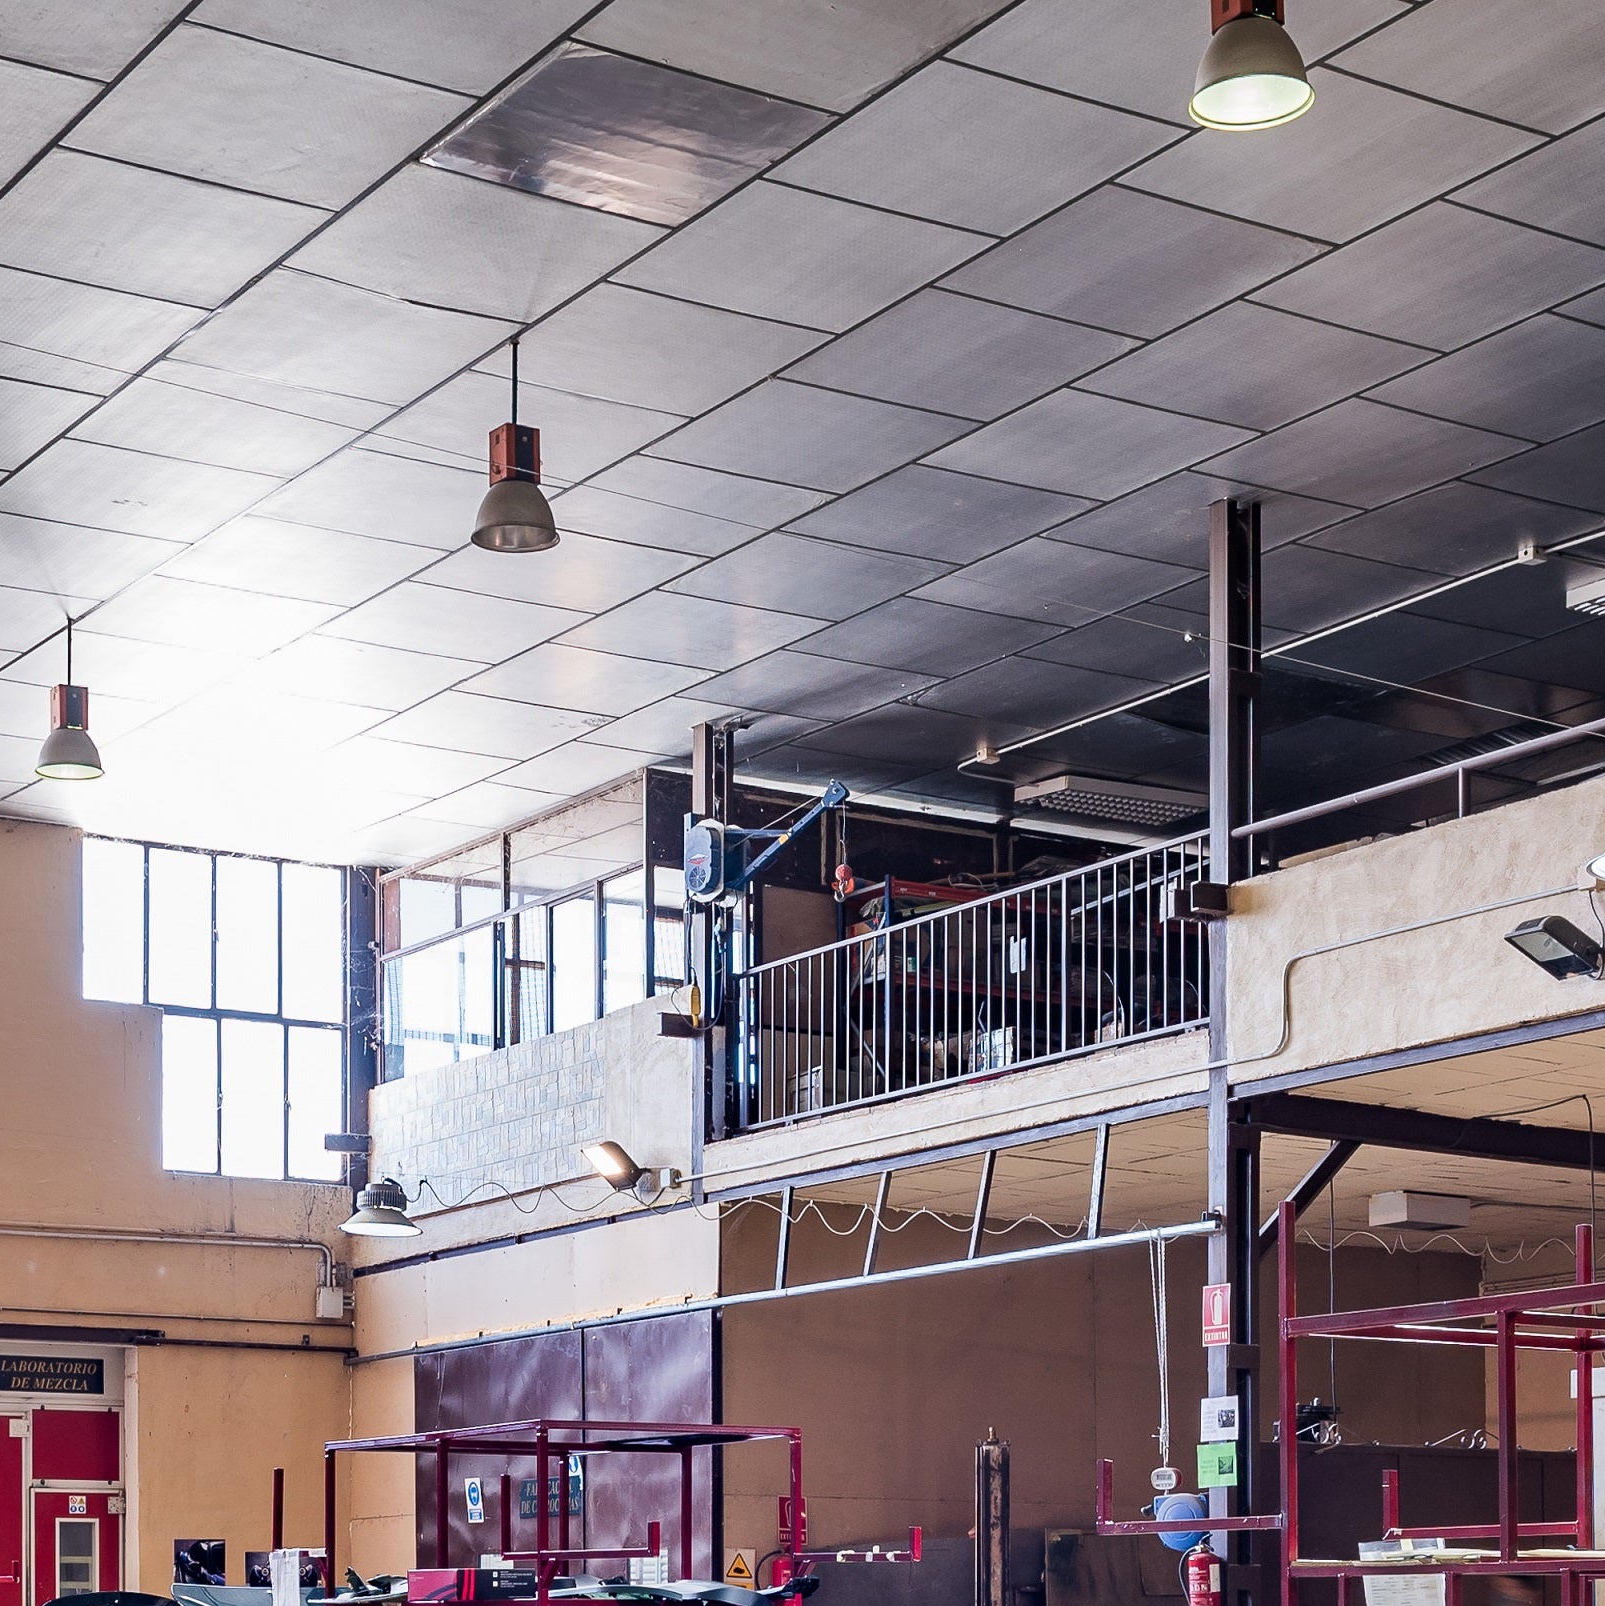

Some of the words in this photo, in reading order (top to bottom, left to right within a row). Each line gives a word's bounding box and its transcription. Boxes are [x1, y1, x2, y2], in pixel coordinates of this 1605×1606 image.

[0, 1359, 97, 1375] LABORATORIO
[11, 1376, 30, 1388] DE
[33, 1378, 88, 1391] MEZCLA
